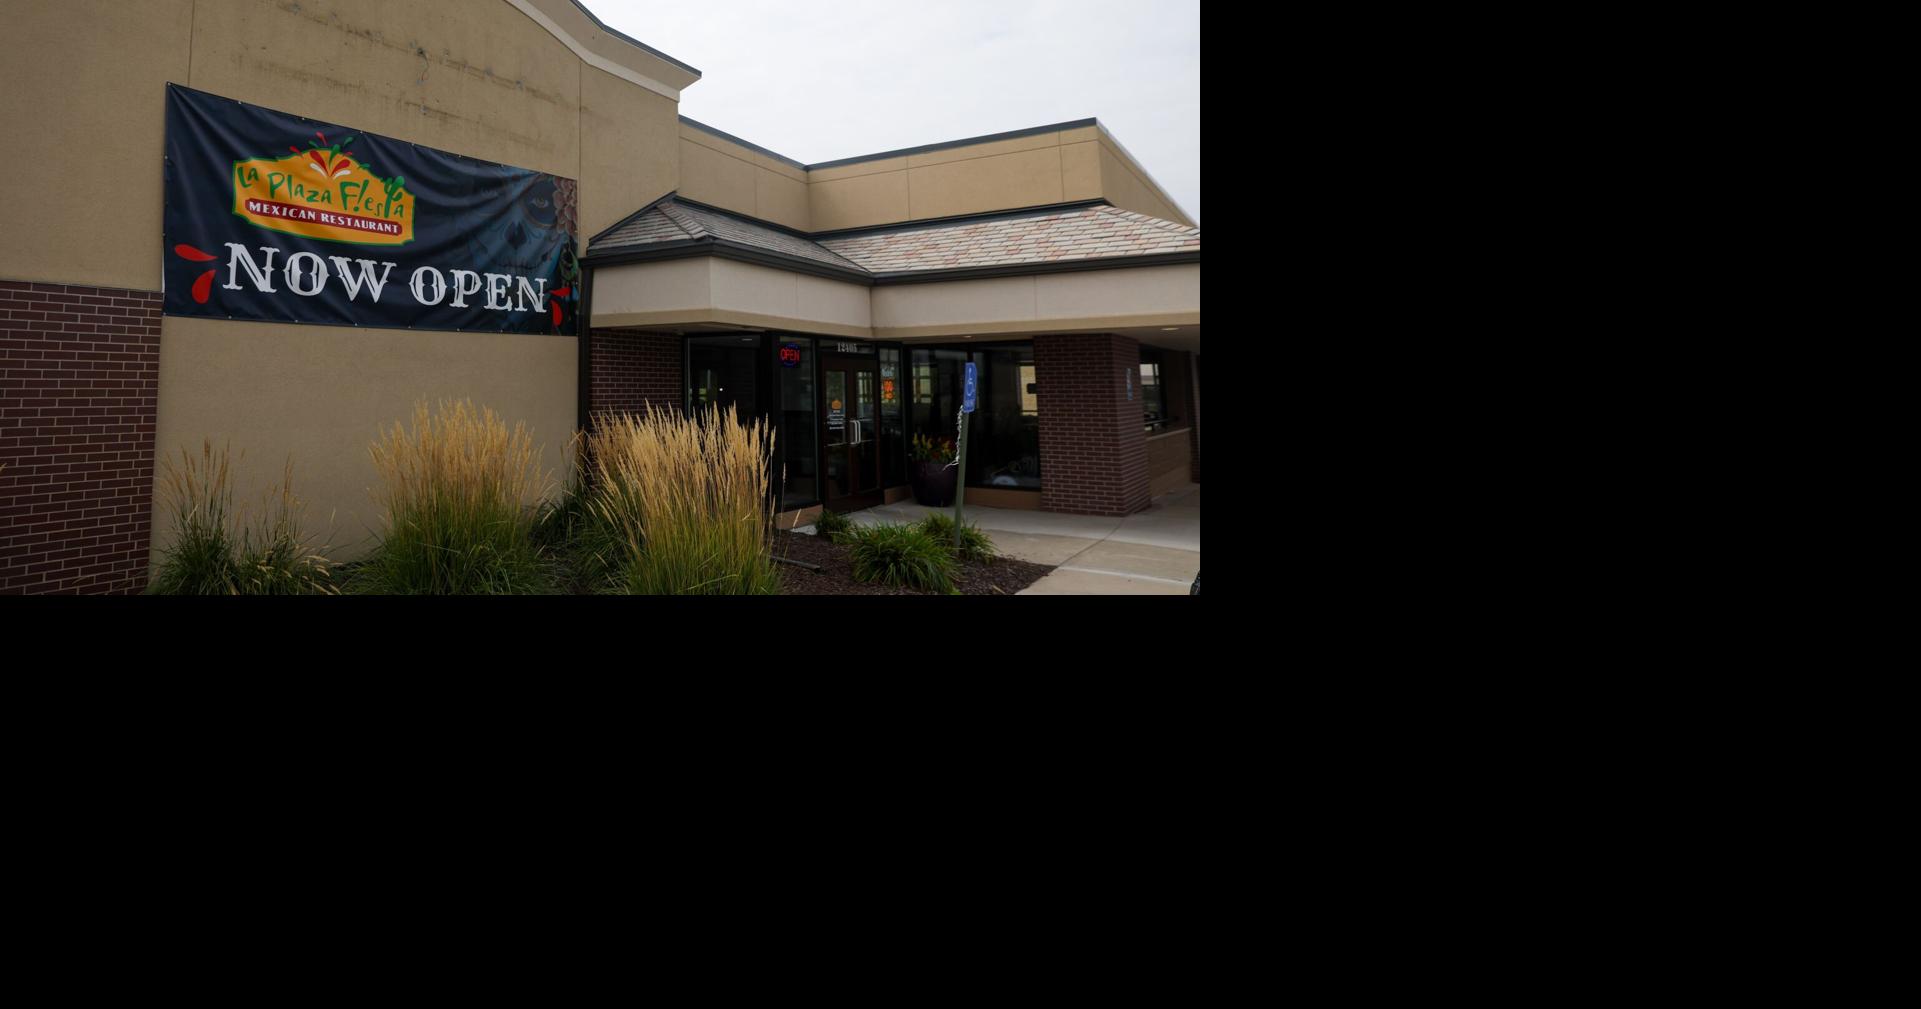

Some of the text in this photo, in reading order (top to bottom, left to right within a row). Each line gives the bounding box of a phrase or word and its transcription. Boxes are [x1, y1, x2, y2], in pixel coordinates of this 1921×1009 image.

[237, 166, 259, 189] La
[267, 172, 333, 205] Plaza
[249, 201, 399, 234] MEXICAN RESTAURANT
[223, 242, 547, 313] NOW OPEN
[780, 347, 800, 361] OPEN
